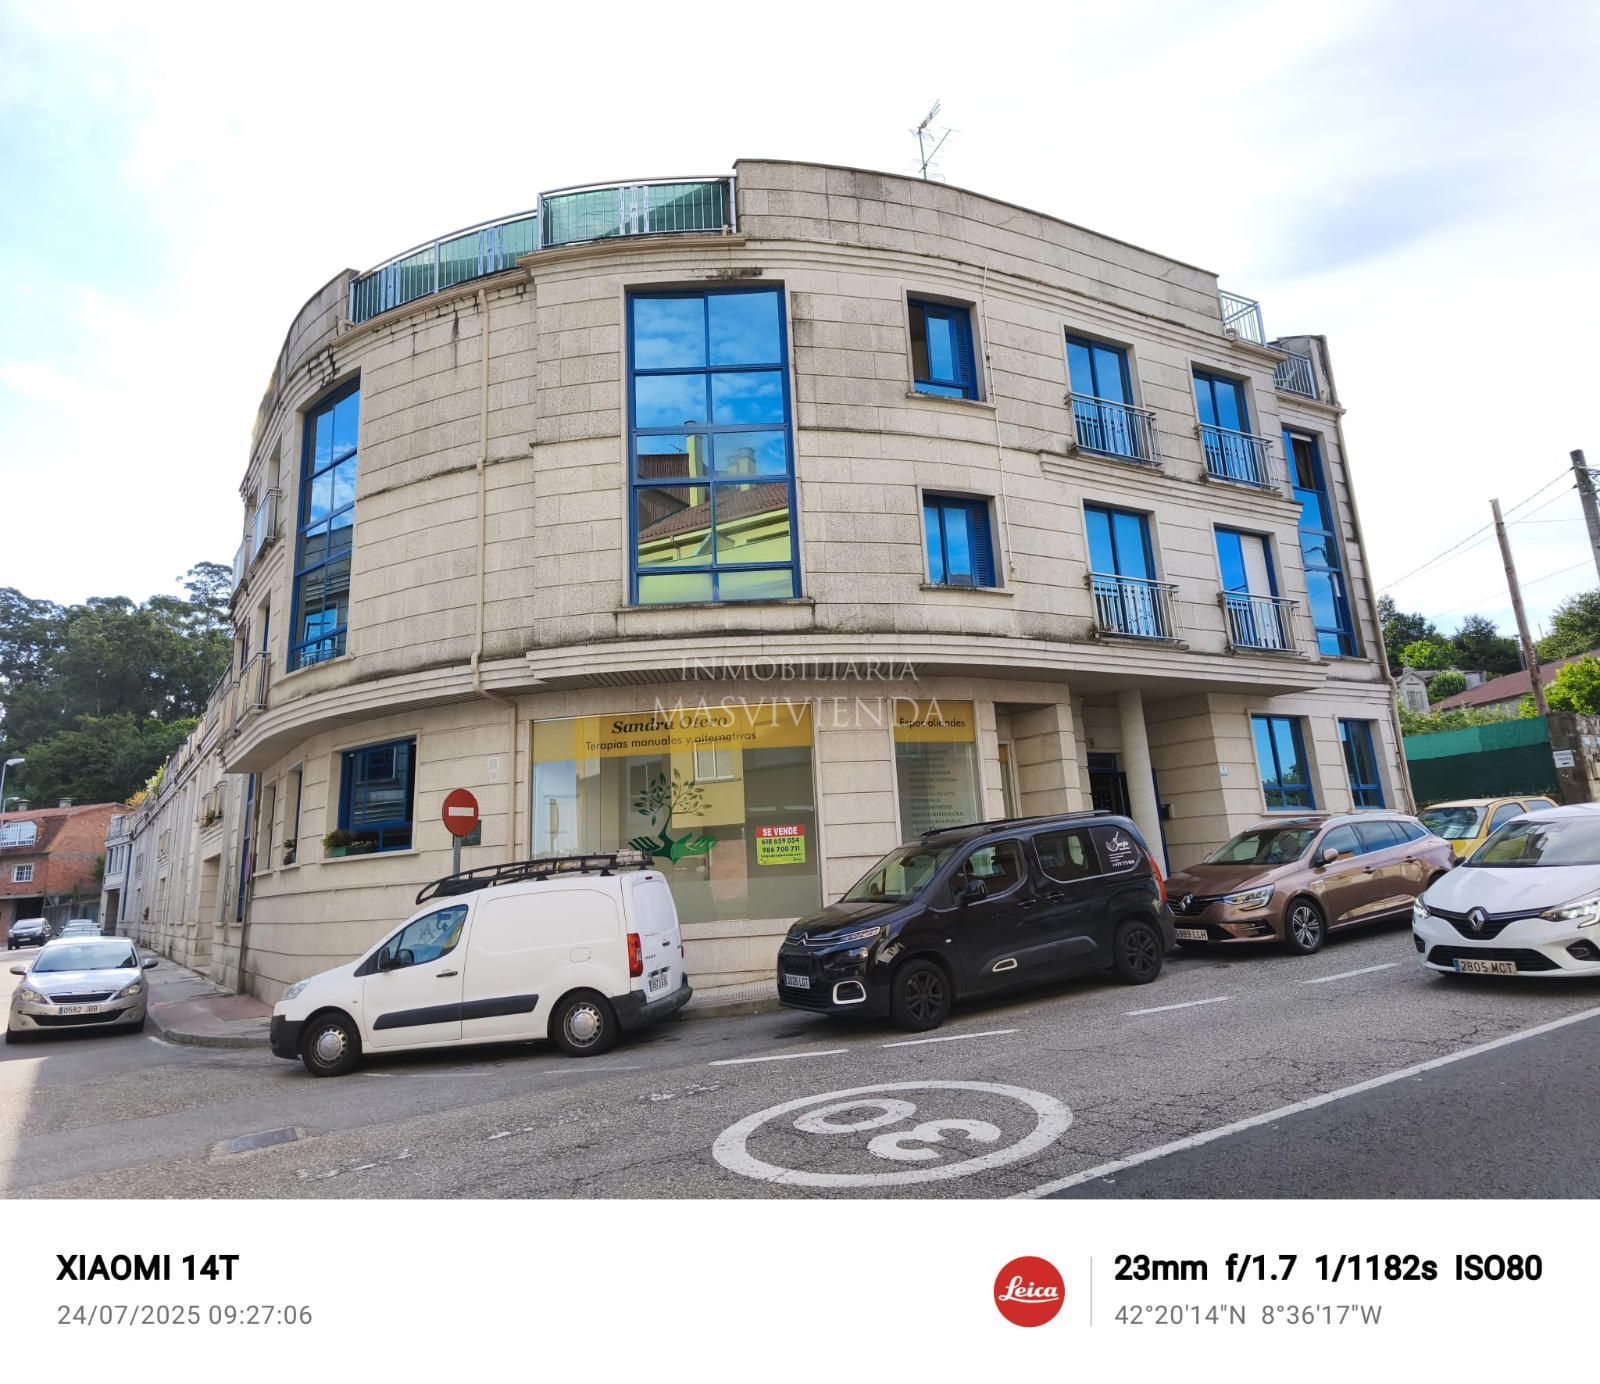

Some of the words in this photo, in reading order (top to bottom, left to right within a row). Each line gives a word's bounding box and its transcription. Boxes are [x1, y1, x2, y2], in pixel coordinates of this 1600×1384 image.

[611, 717, 674, 734] Sandra
[679, 715, 728, 730] Otero
[585, 740, 628, 752] Terapias
[631, 734, 683, 747] manuales
[686, 736, 692, 746] y
[694, 730, 757, 743] alternativas
[762, 827, 772, 837] SE
[773, 826, 798, 836] VENDE
[761, 846, 775, 854] 986
[1460, 960, 1488, 973] 2805
[1491, 962, 1513, 974] MCT
